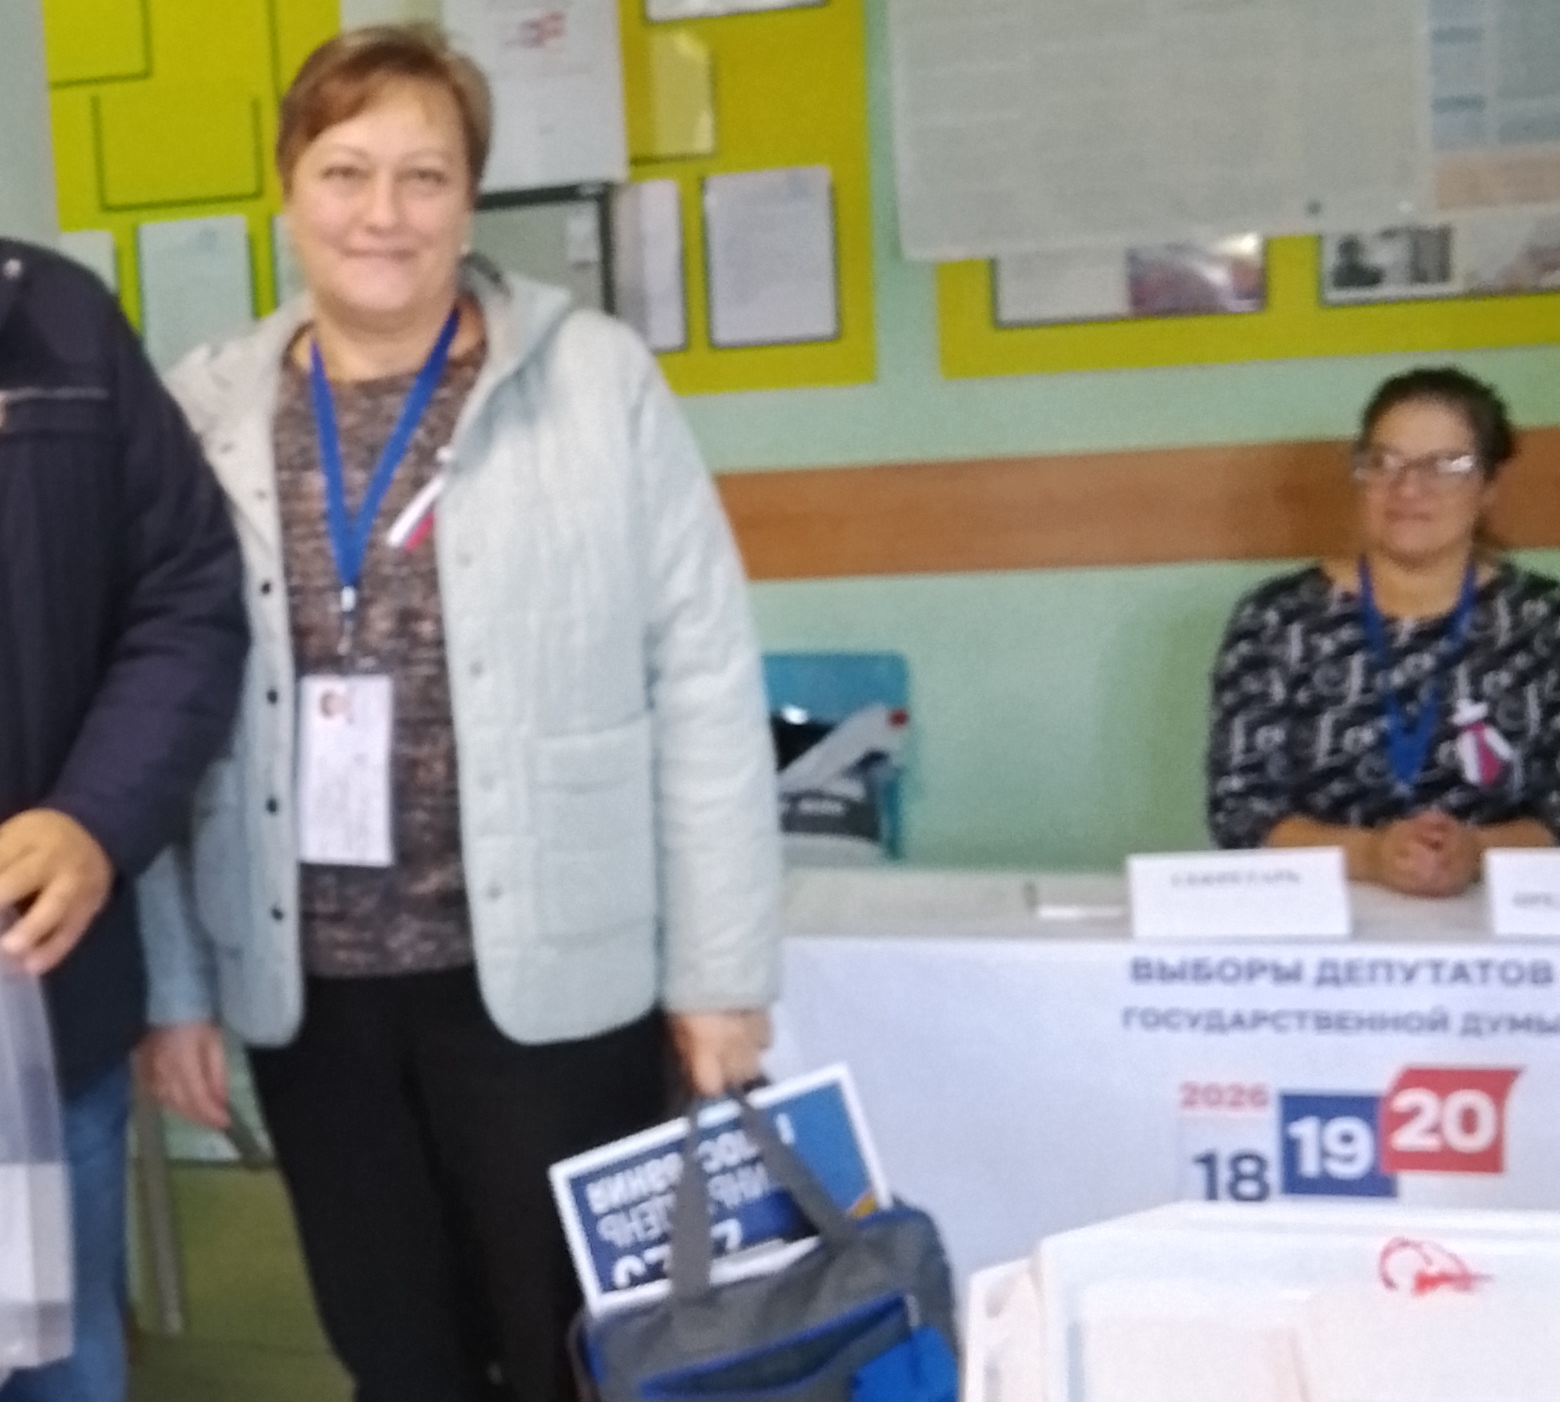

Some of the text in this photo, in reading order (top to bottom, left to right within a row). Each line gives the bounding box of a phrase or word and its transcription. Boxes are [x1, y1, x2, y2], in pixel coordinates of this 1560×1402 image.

[1130, 955, 1555, 988] ВЫБОРЫ ДЕПУТАТОВ
[1122, 1005, 1449, 1035] ГОСУДАРСТВЕННОЙ
[1179, 1083, 1269, 1108] 2026
[1192, 1087, 1499, 1202] 18 19 20
